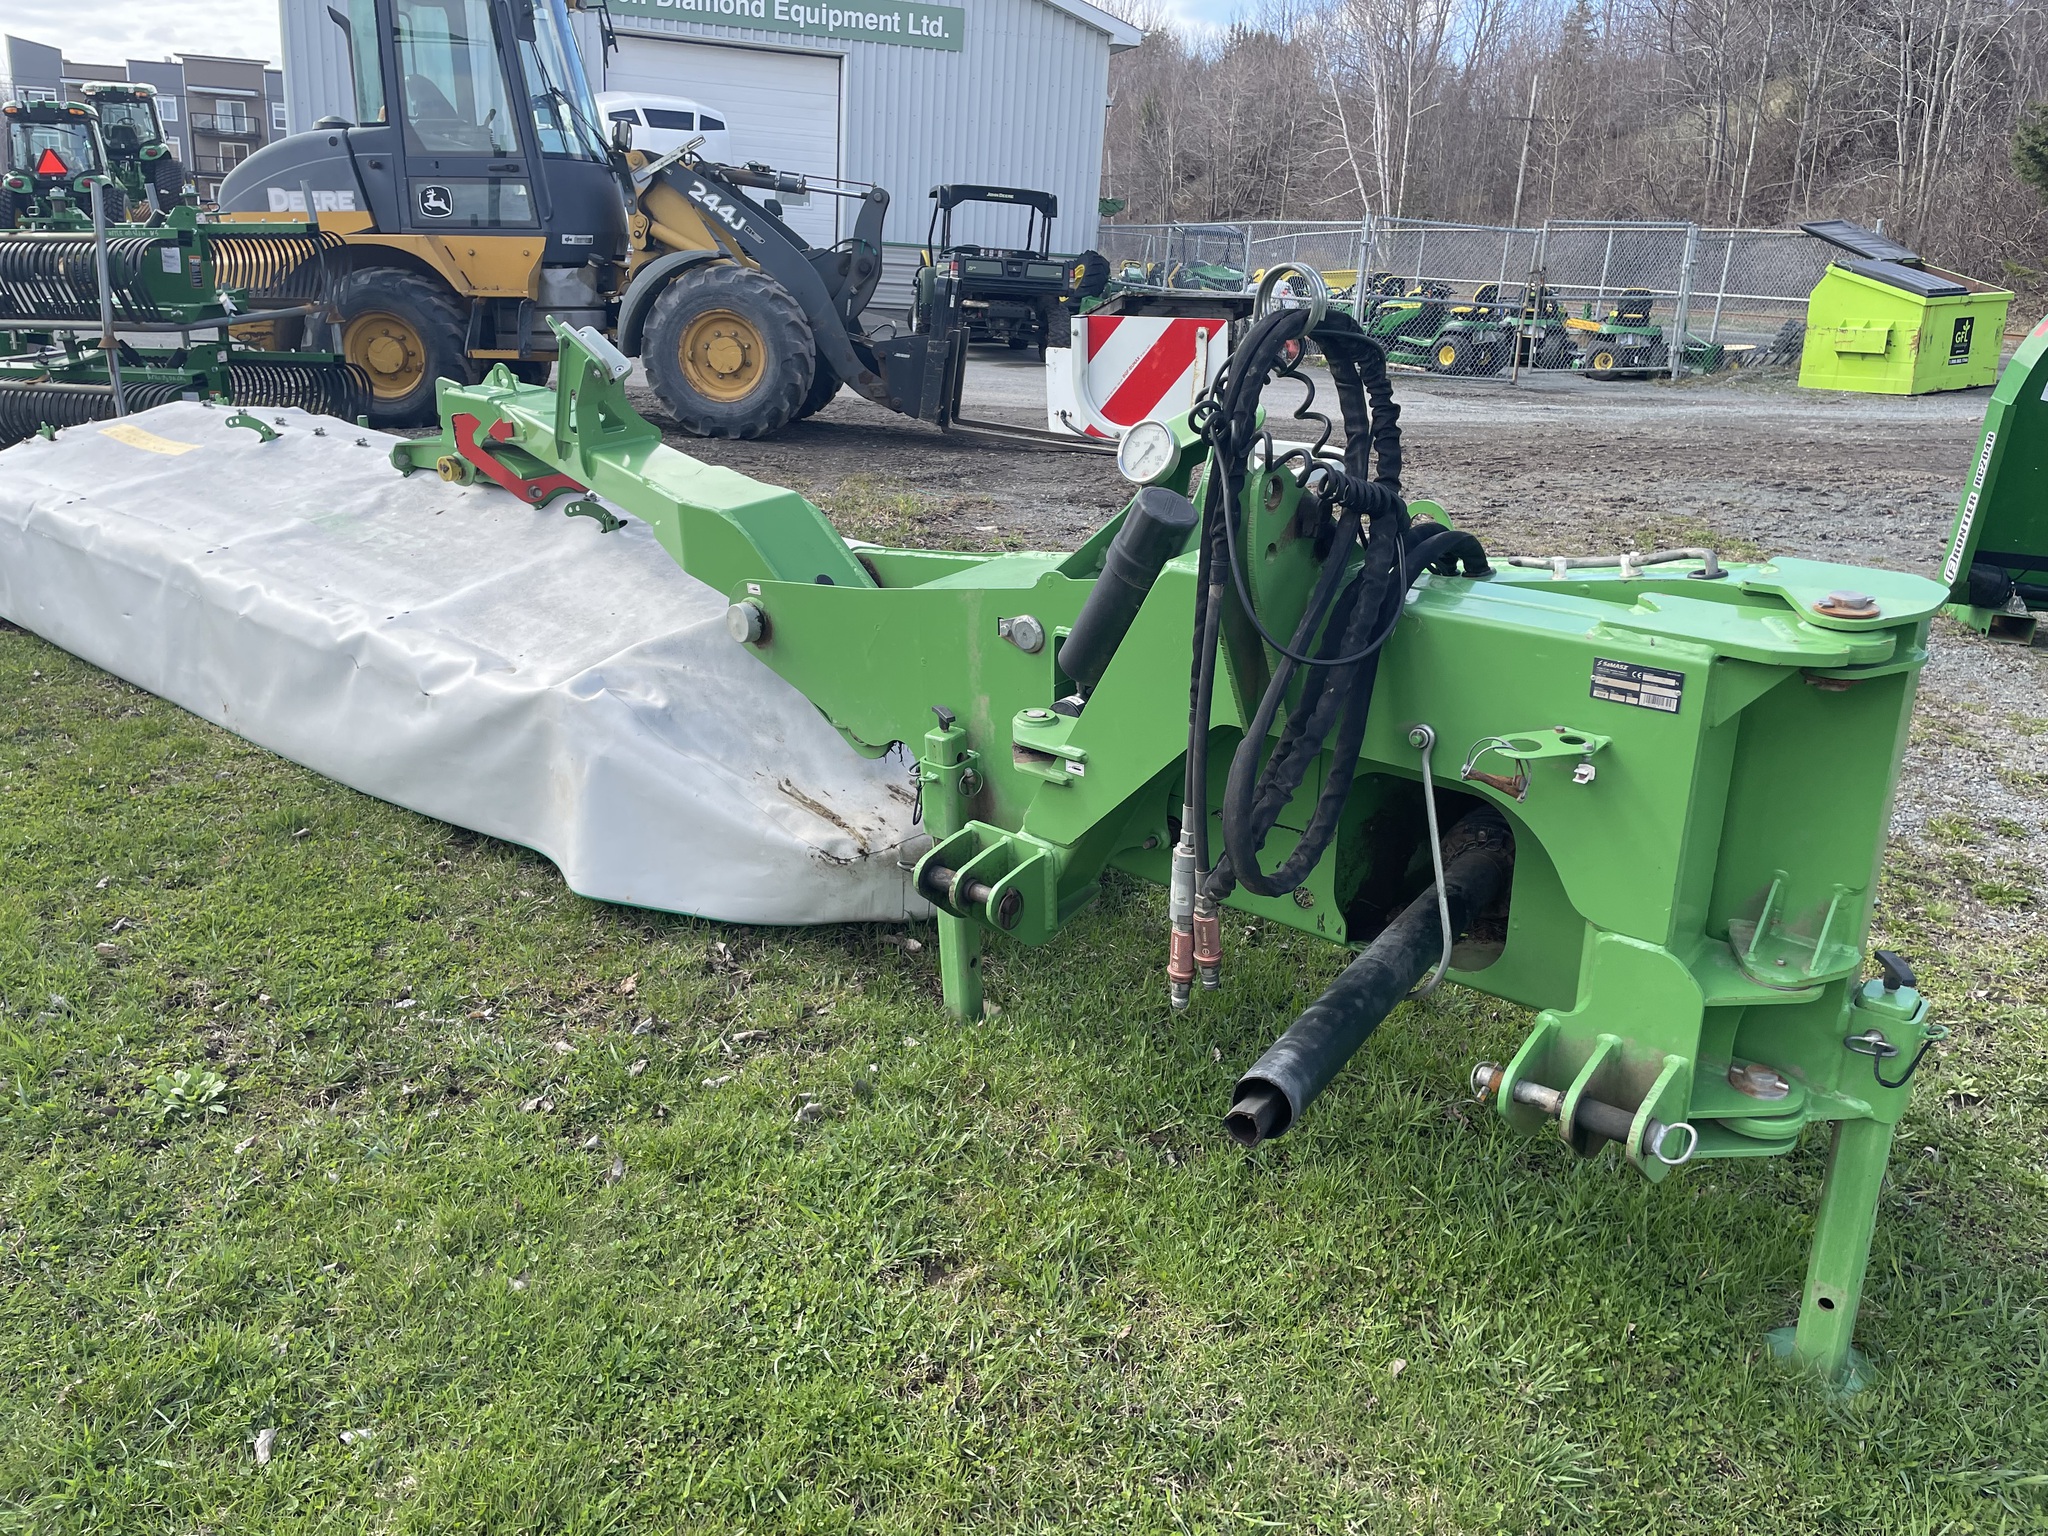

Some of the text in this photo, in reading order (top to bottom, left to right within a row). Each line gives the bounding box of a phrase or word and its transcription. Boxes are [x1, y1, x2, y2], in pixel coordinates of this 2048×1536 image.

[774, 0, 901, 32] Equipment
[908, 13, 949, 38] Ltd.
[688, 181, 747, 231] 244J
[1955, 329, 1968, 344] GFL
[1945, 494, 1977, 582] FRONTIER
[1631, 671, 1642, 680] CE
